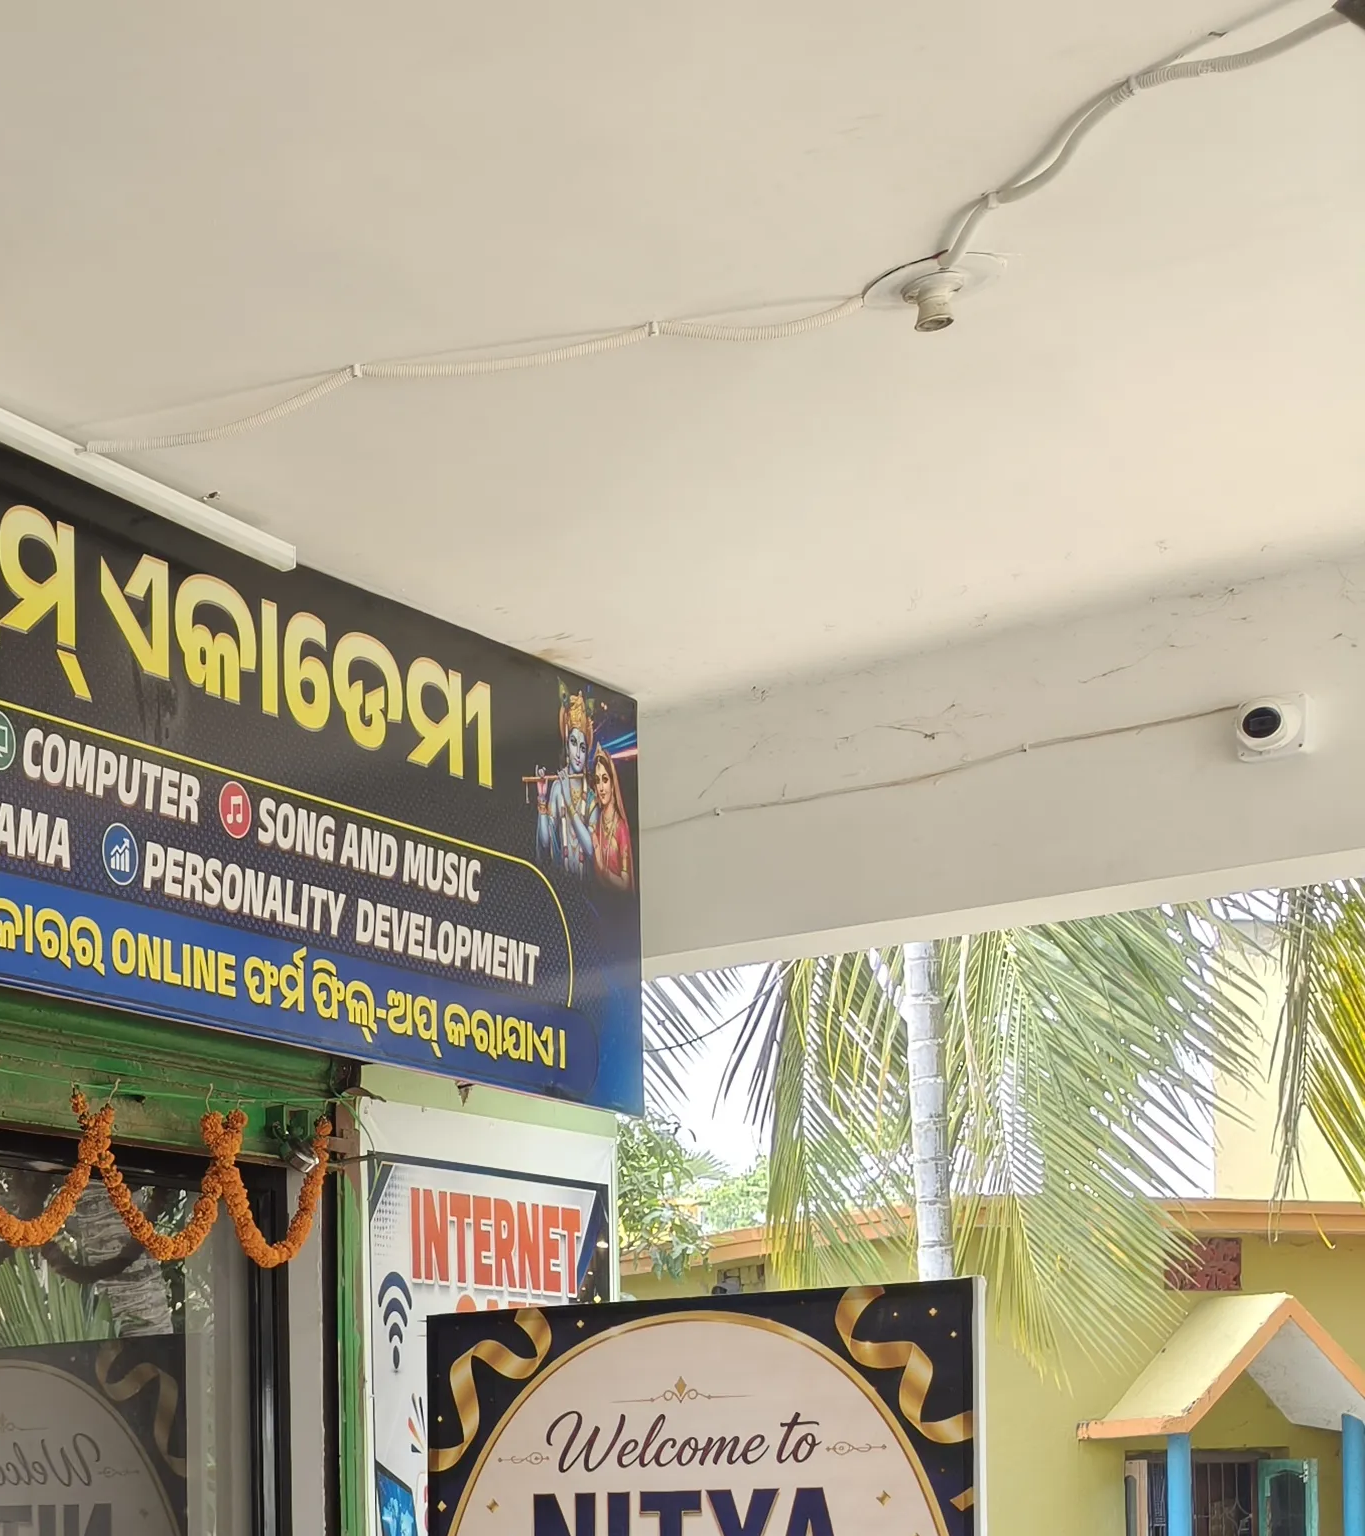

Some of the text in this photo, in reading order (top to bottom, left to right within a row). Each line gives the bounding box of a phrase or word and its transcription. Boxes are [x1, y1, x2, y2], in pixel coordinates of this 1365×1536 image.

[22, 727, 199, 826] COMPUTER
[257, 797, 335, 863] SONG
[340, 827, 399, 880] AND
[403, 845, 482, 903] MUSIC
[111, 927, 236, 997] ONLINE
[144, 841, 346, 937] PERSONALITY
[356, 898, 540, 986] DEVELOPMENT
[410, 1186, 581, 1298] INTERNET
[545, 1410, 822, 1474] Welcome to
